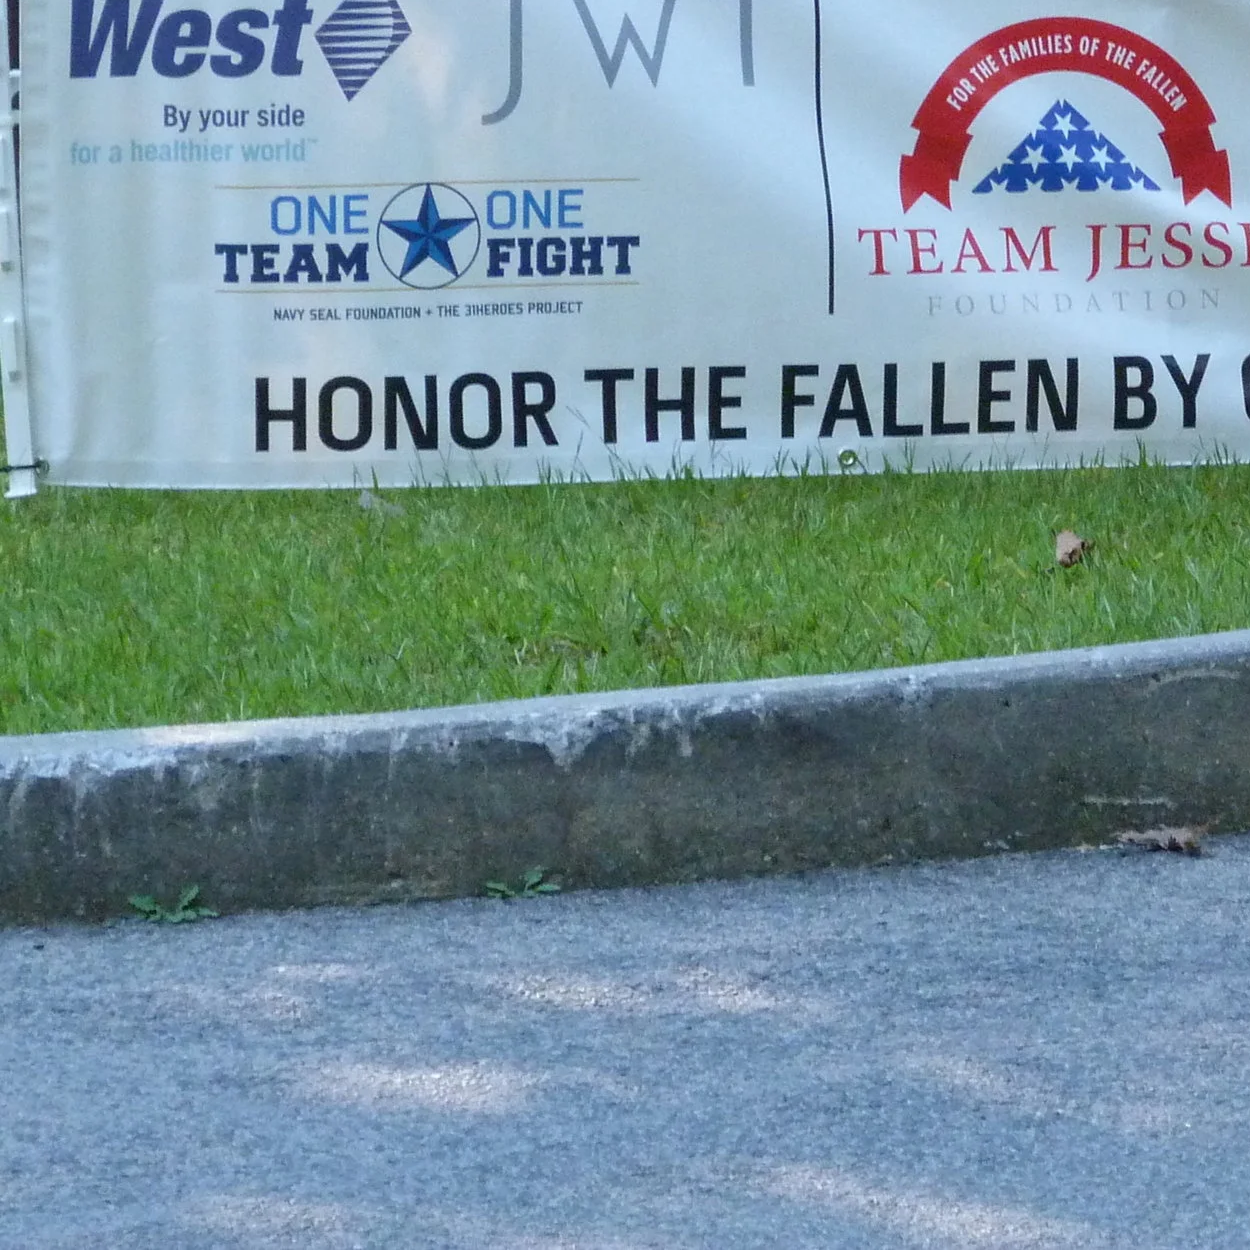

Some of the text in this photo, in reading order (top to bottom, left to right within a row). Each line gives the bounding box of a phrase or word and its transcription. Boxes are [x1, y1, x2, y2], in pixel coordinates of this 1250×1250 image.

[946, 34, 1188, 112] FOR THE FAMILIES OF THE FALLEN
[163, 103, 305, 132] By your side
[71, 142, 101, 164] for
[108, 145, 121, 164] a
[131, 140, 235, 162] healthier
[270, 194, 369, 236] ONE
[486, 189, 584, 230] ONE
[214, 243, 369, 283] TEAM
[486, 236, 639, 278] FIGHT
[857, 225, 1058, 276] TEAM
[273, 309, 305, 321] NAVY
[310, 308, 341, 320] SEAL
[346, 305, 421, 319] FOUNDATION
[436, 304, 460, 317] THE
[528, 301, 583, 316] PROJECT
[927, 287, 1222, 318] FOUNDATION
[255, 369, 557, 453] HONOR
[583, 365, 747, 443] THE
[781, 356, 1078, 439] FALLEN
[1112, 352, 1210, 431] BY
